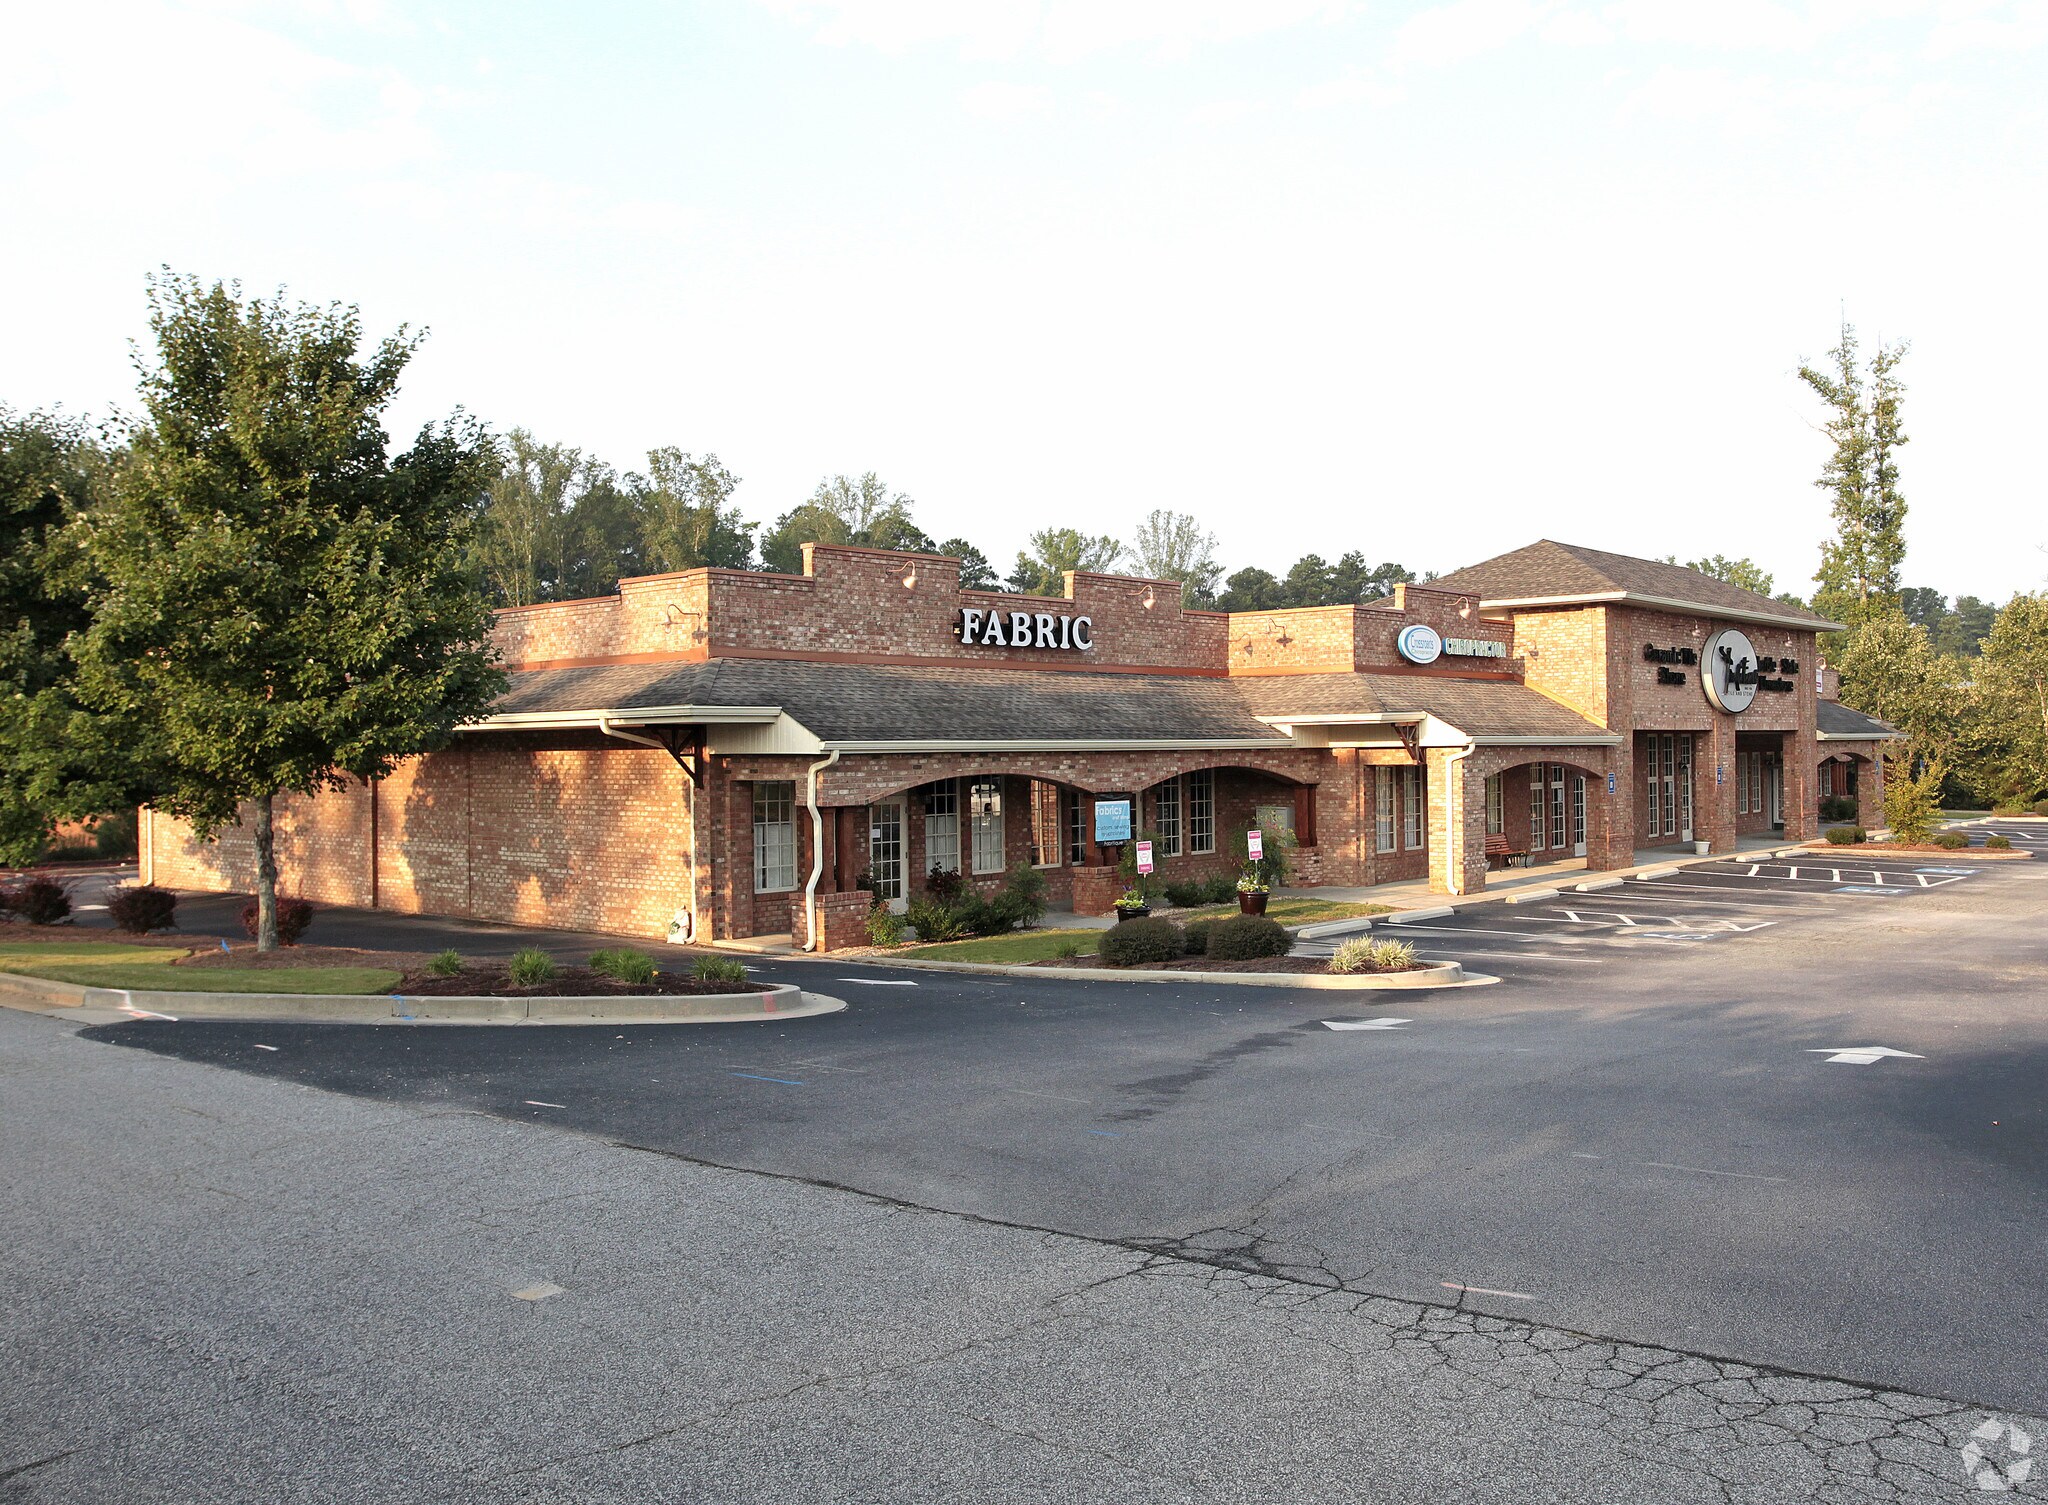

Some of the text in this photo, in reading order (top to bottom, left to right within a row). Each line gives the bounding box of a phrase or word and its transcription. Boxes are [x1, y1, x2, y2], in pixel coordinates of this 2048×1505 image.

[961, 608, 1093, 650] FABRIC
[1445, 638, 1506, 658] CHIROPRACTOR
[1096, 806, 1122, 815] Fabrics
